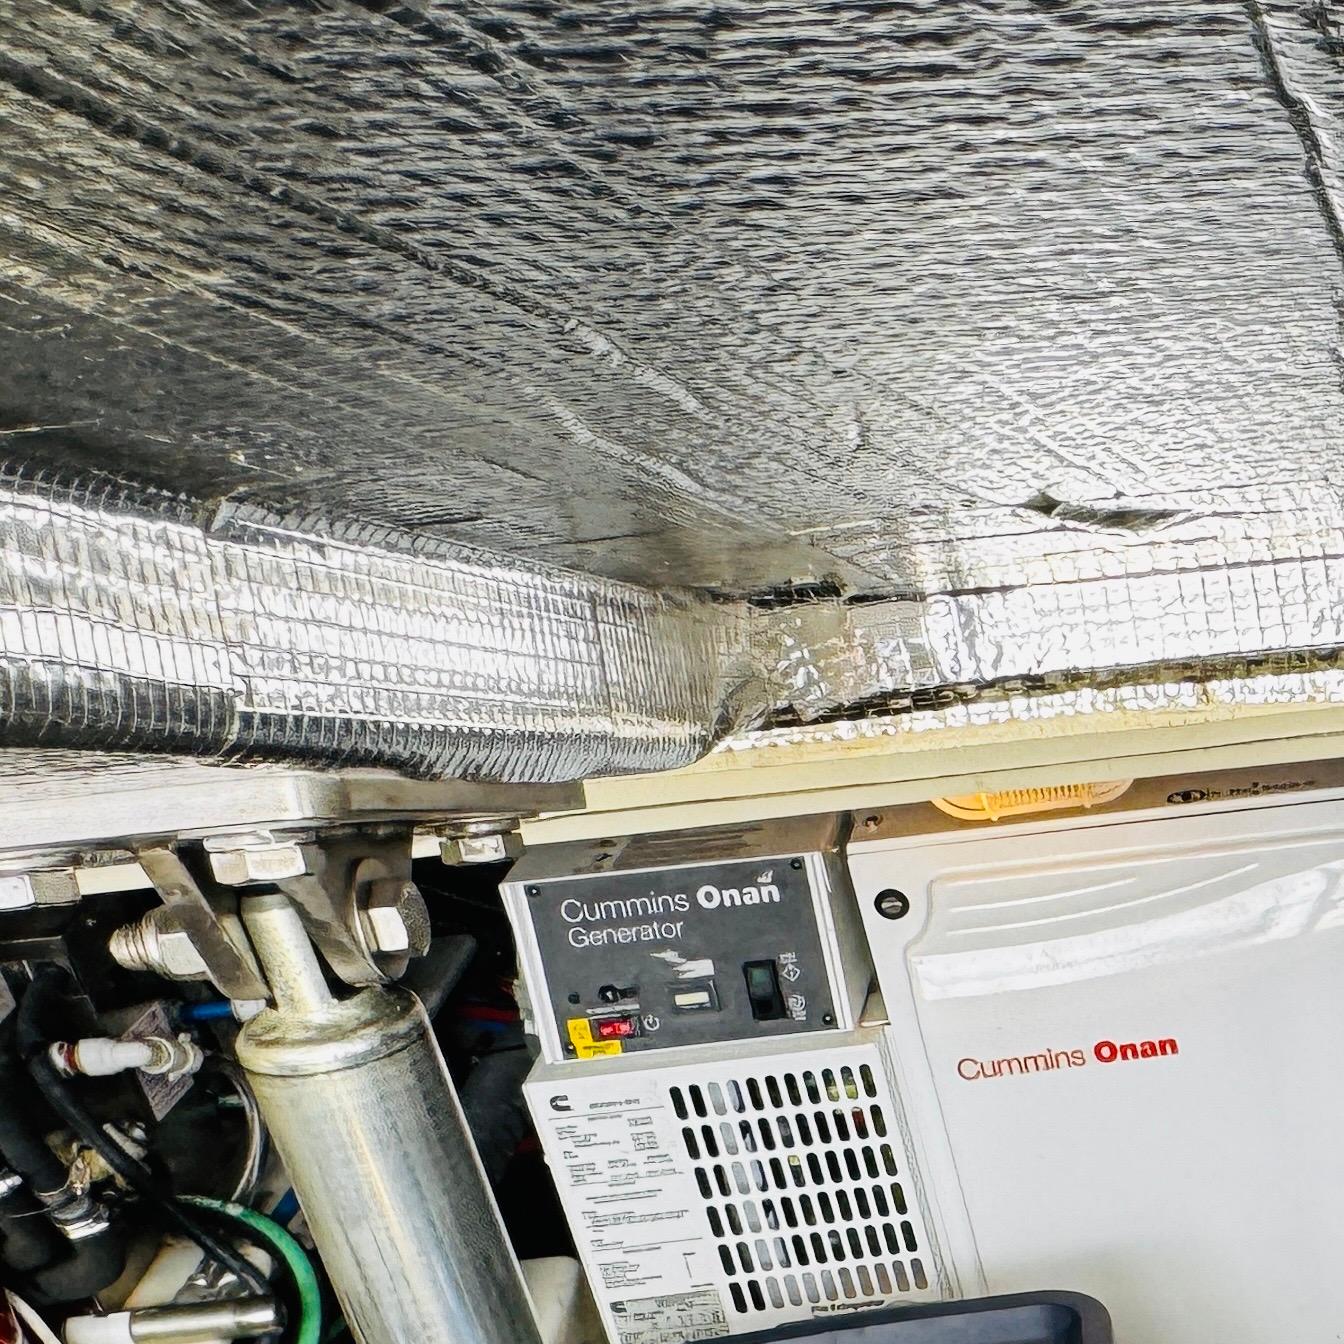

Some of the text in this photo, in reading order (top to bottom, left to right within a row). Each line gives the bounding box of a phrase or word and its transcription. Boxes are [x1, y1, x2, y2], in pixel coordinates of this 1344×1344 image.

[560, 883, 780, 923] Cummins Onan
[568, 920, 684, 948] Generator
[957, 1037, 1179, 1081] Cummins Onan
